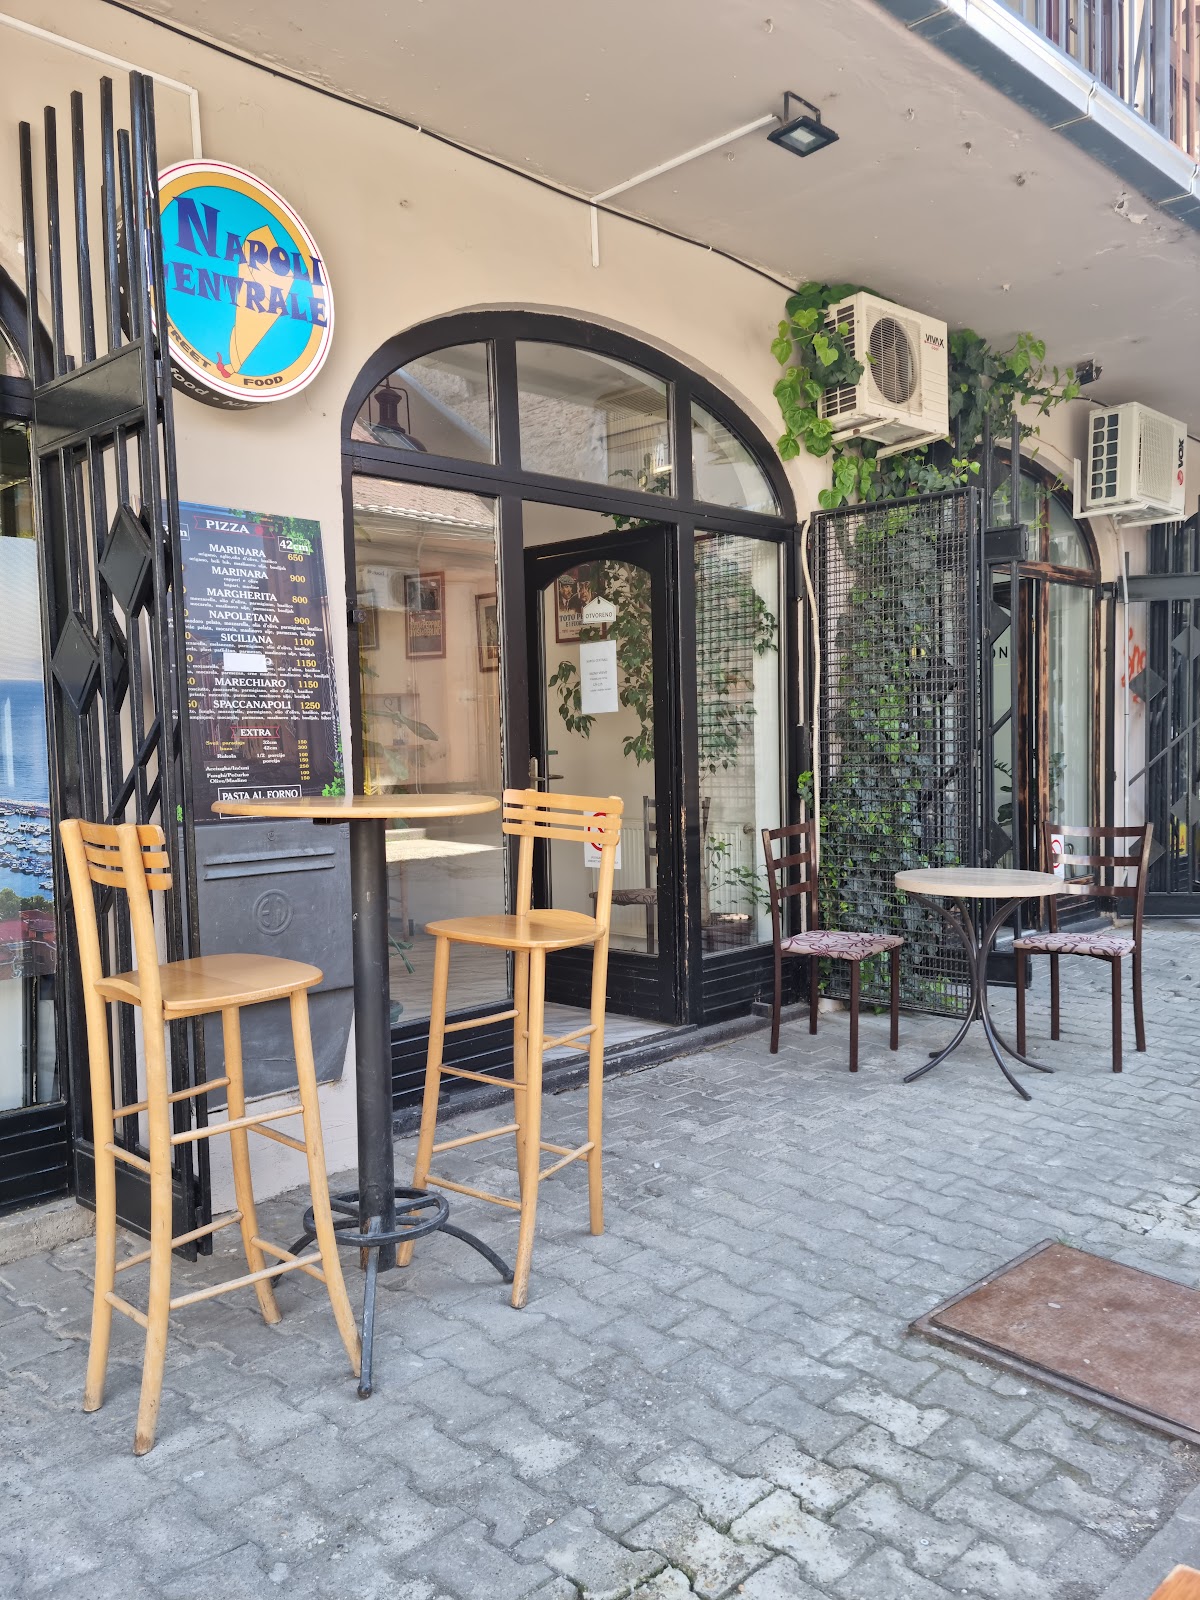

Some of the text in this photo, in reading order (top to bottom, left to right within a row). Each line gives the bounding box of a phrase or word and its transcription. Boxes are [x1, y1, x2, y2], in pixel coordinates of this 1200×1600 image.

[173, 197, 325, 286] NAPOLI
[165, 261, 327, 327] ENTRALE
[166, 320, 211, 369] TREET
[925, 333, 945, 349] VIVAX
[243, 376, 283, 387] FOOD
[205, 519, 250, 534] PIZZA
[209, 543, 266, 558] MARINARA
[279, 539, 309, 552] 42cm
[288, 553, 304, 562] 650
[211, 565, 269, 580] MARINARA
[289, 574, 306, 583] 900
[206, 587, 278, 602] MARGHERITA
[292, 595, 308, 604] 800
[209, 610, 279, 624] NAPOLETANA
[294, 617, 310, 626] 900
[220, 633, 273, 645] SICILIANA
[294, 638, 315, 647] 1100
[296, 659, 317, 668] 1150
[214, 677, 287, 688] MARECHIARO
[298, 680, 319, 689] 1150
[213, 699, 292, 710] SPACCANAPOLI
[300, 701, 321, 710] 1250
[240, 728, 272, 737] EXTRA
[222, 791, 250, 801] PASTA
[266, 788, 299, 799] FORNO
